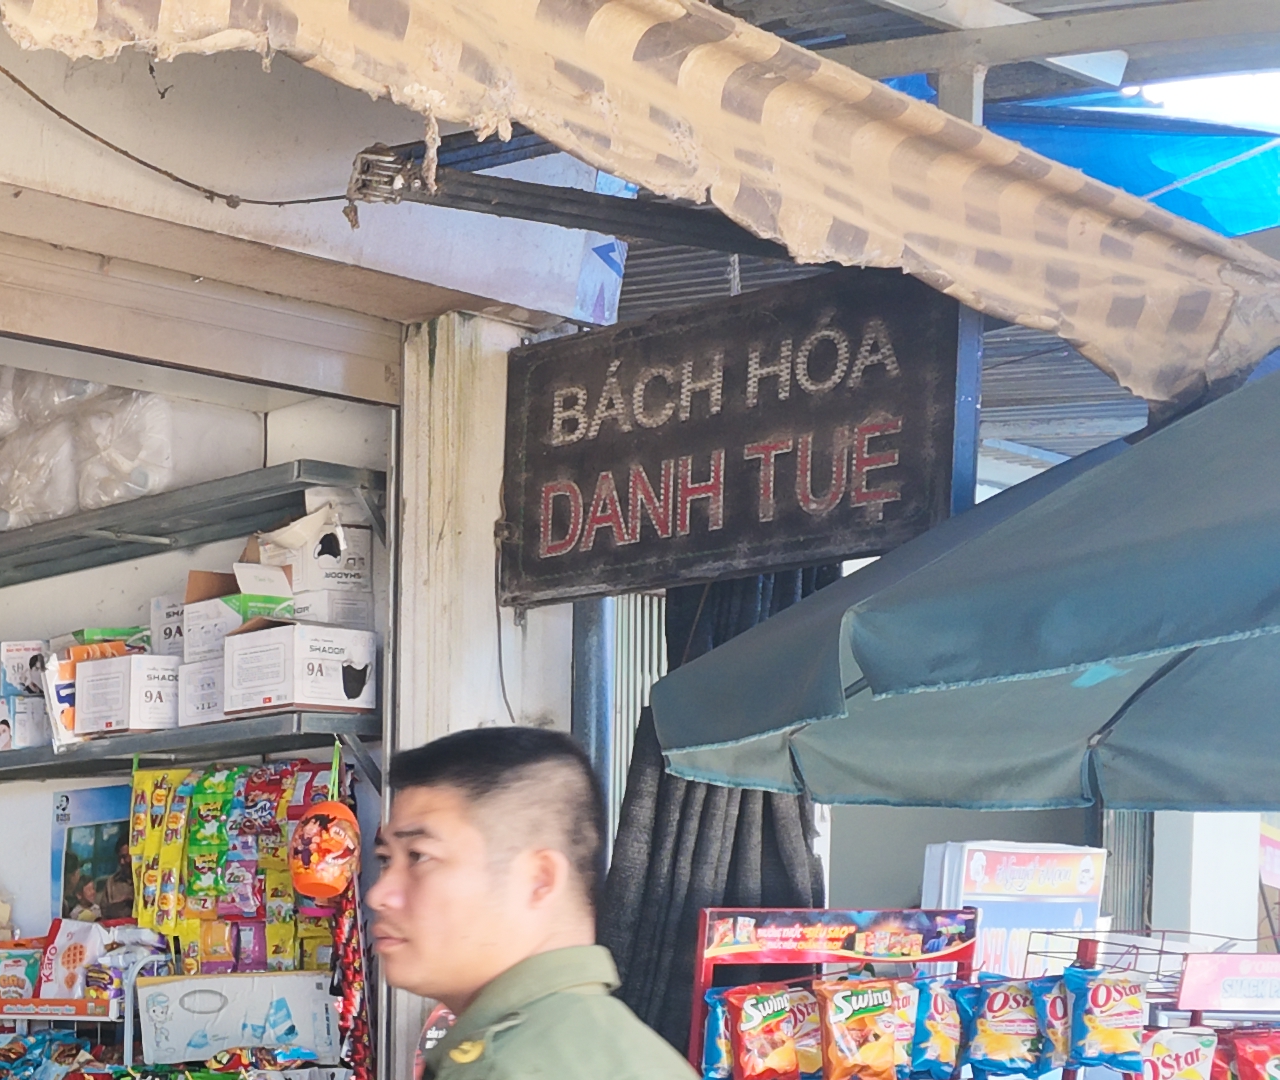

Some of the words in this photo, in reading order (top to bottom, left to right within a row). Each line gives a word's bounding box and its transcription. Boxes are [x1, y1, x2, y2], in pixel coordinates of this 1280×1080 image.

[548, 360, 724, 447] BÁCH
[745, 307, 901, 408] HÓA
[539, 448, 726, 560] DANH
[744, 411, 903, 522] TUỆ
[163, 626, 184, 640] 9A
[309, 645, 345, 655] SHADOR
[306, 662, 324, 677] 9A
[146, 674, 179, 682] SHADO
[144, 690, 164, 704] 9A
[42, 946, 58, 984] Karo
[832, 990, 892, 1023] Swing
